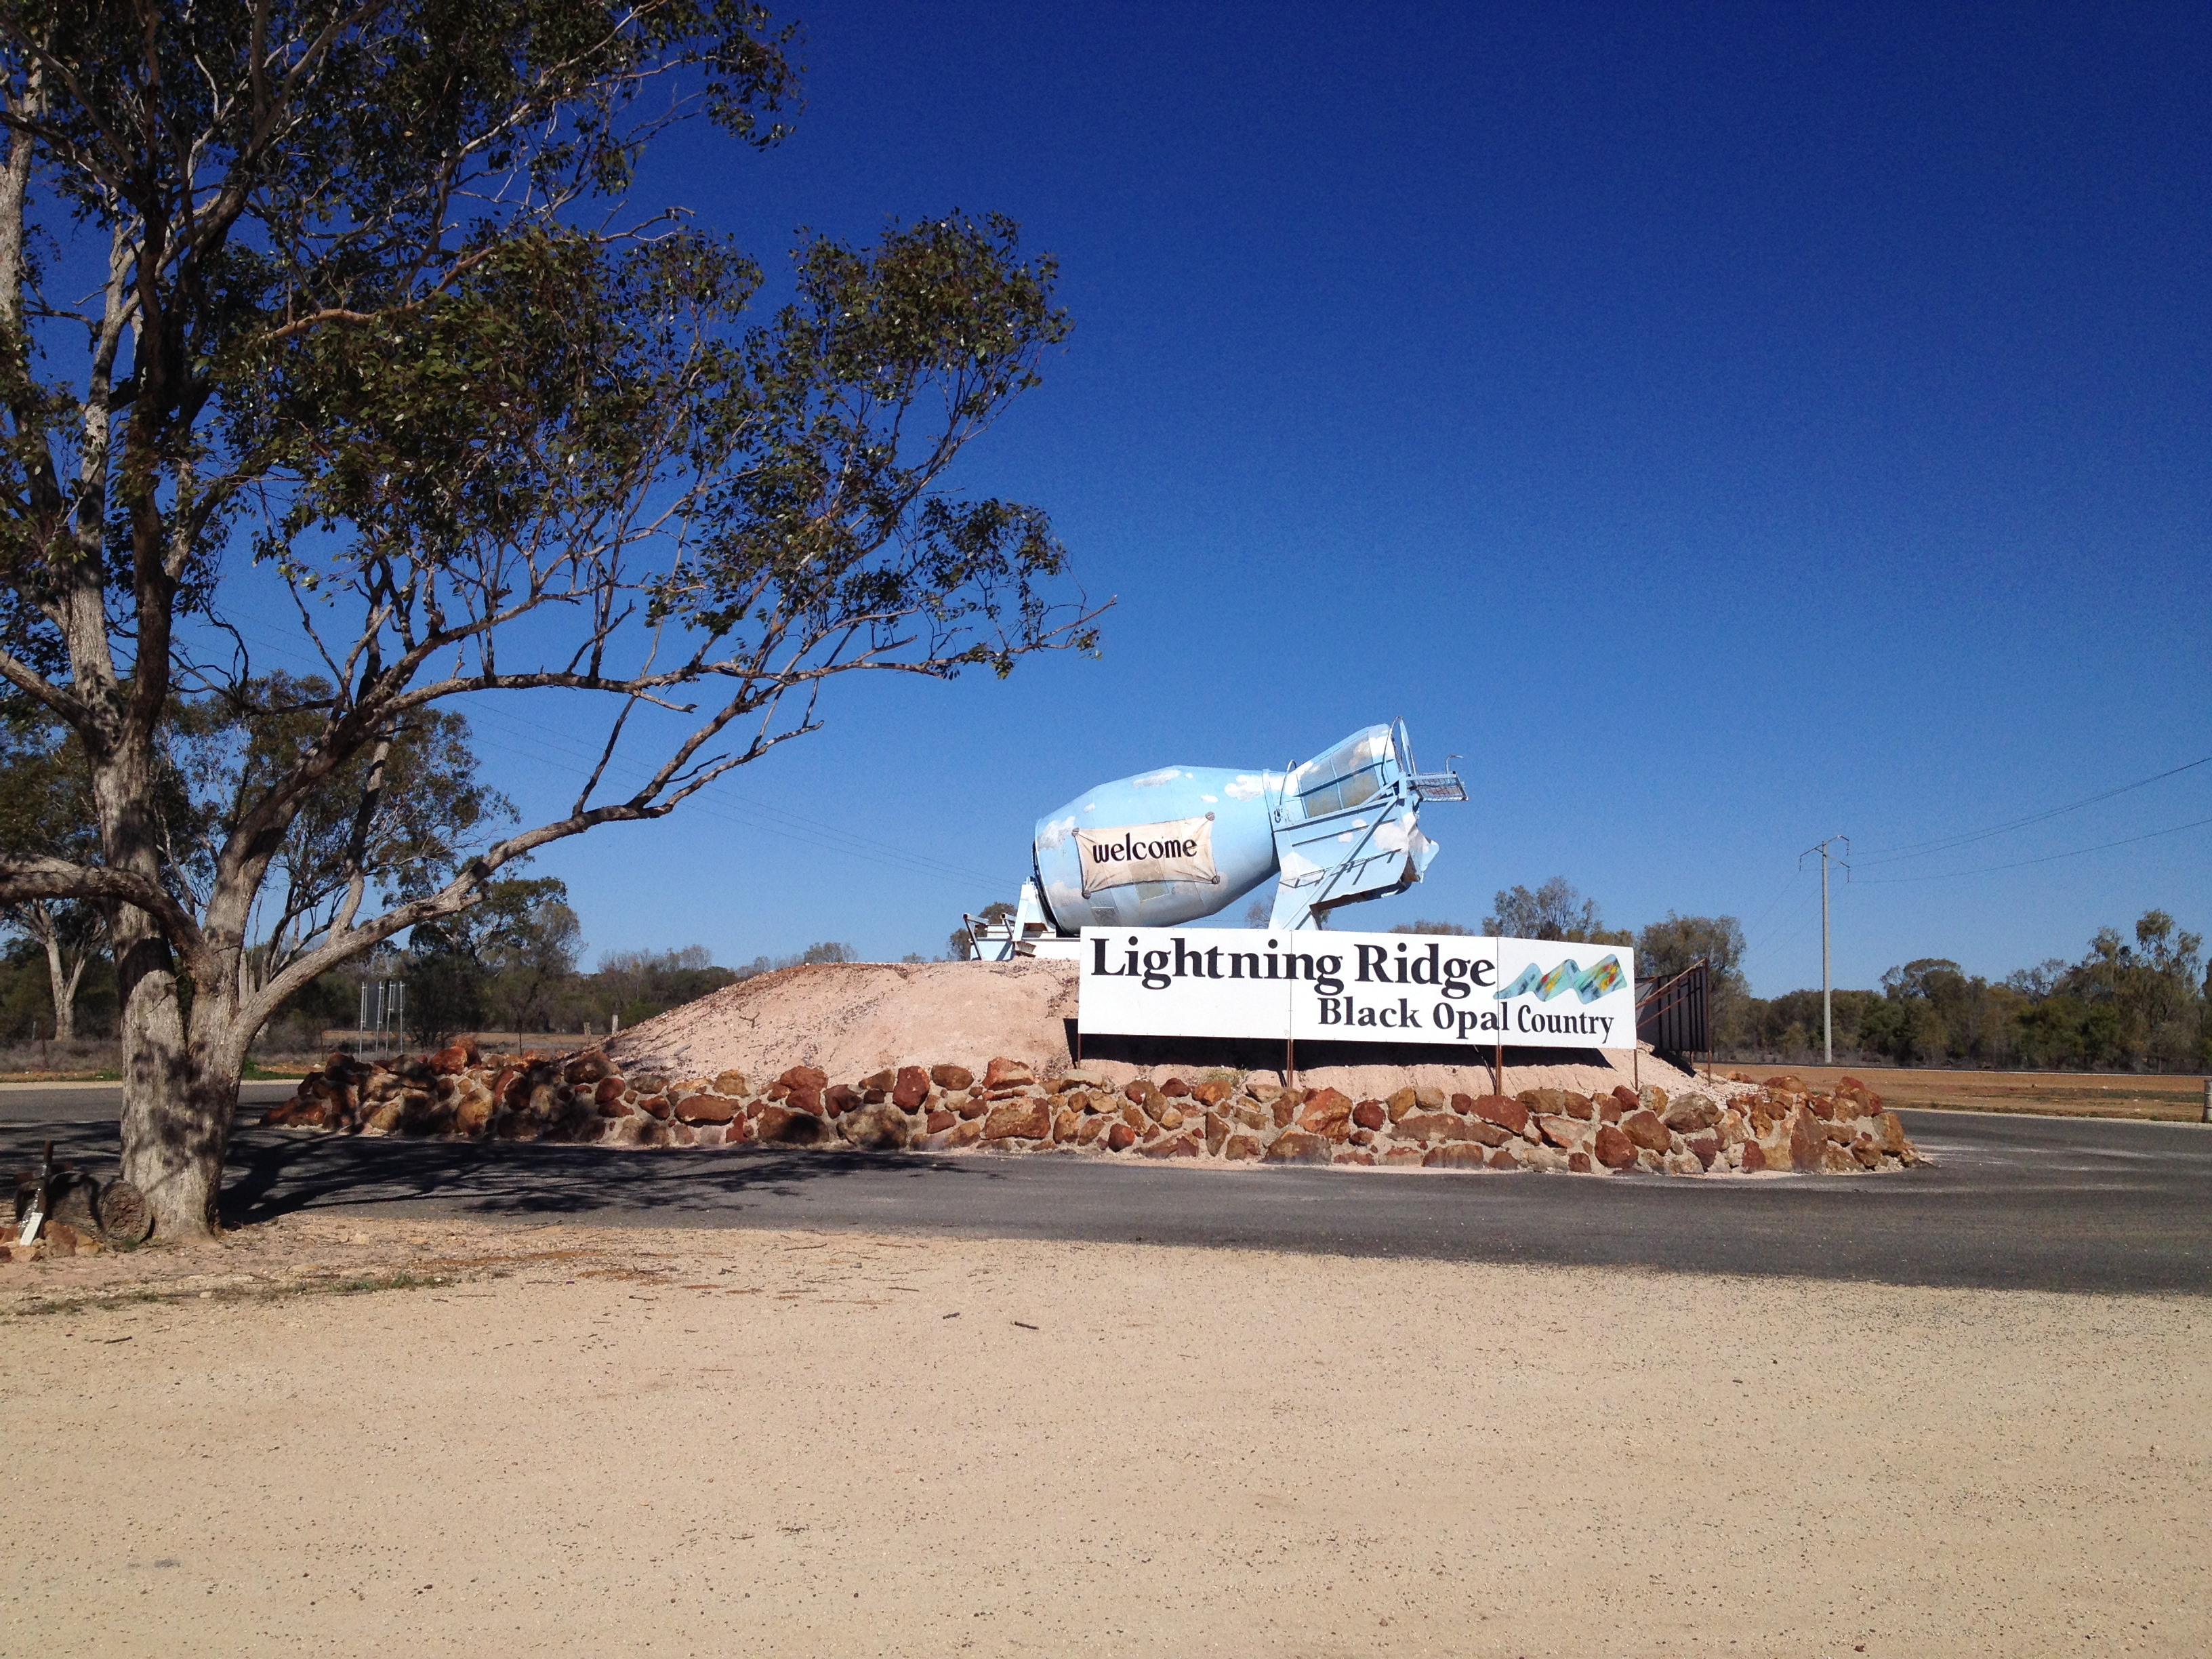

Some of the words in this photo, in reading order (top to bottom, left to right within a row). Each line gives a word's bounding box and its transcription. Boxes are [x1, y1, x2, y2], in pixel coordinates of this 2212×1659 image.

[1092, 832, 1197, 864] welcome
[1090, 935, 1345, 996] Lightning
[1353, 942, 1496, 1000] Ridge
[1317, 998, 1422, 1028] Black
[1433, 1002, 1510, 1040] Opal
[1517, 1004, 1615, 1044] Country
